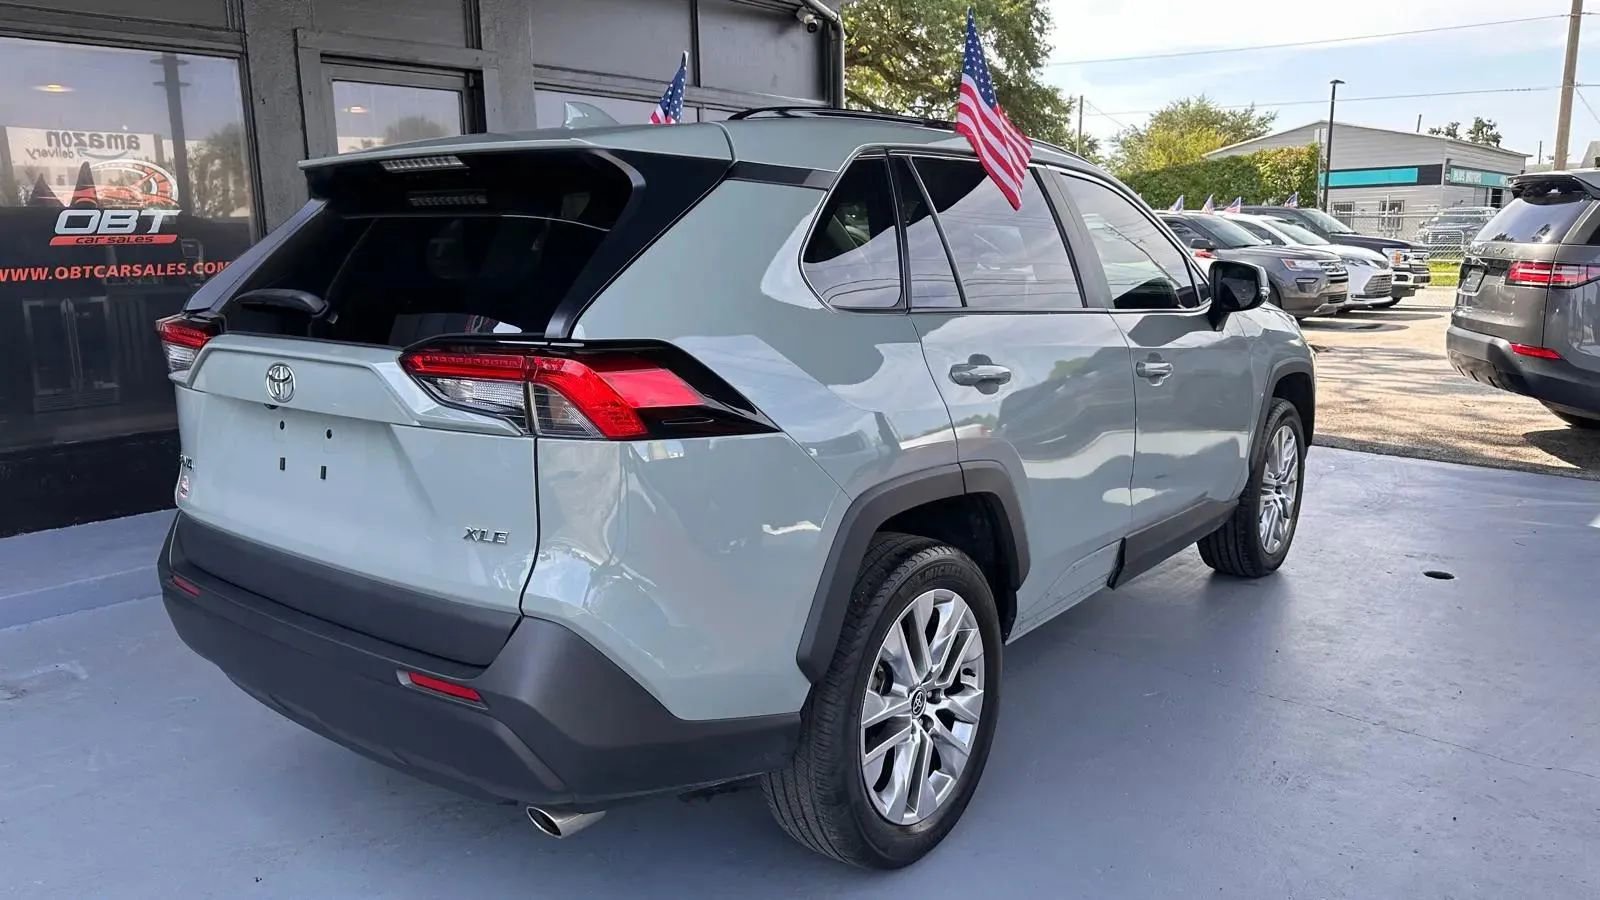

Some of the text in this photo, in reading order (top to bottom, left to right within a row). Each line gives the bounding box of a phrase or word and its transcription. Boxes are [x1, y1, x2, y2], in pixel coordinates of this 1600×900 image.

[55, 209, 182, 234] OBT
[75, 236, 105, 244] car
[463, 526, 510, 546] XLE
